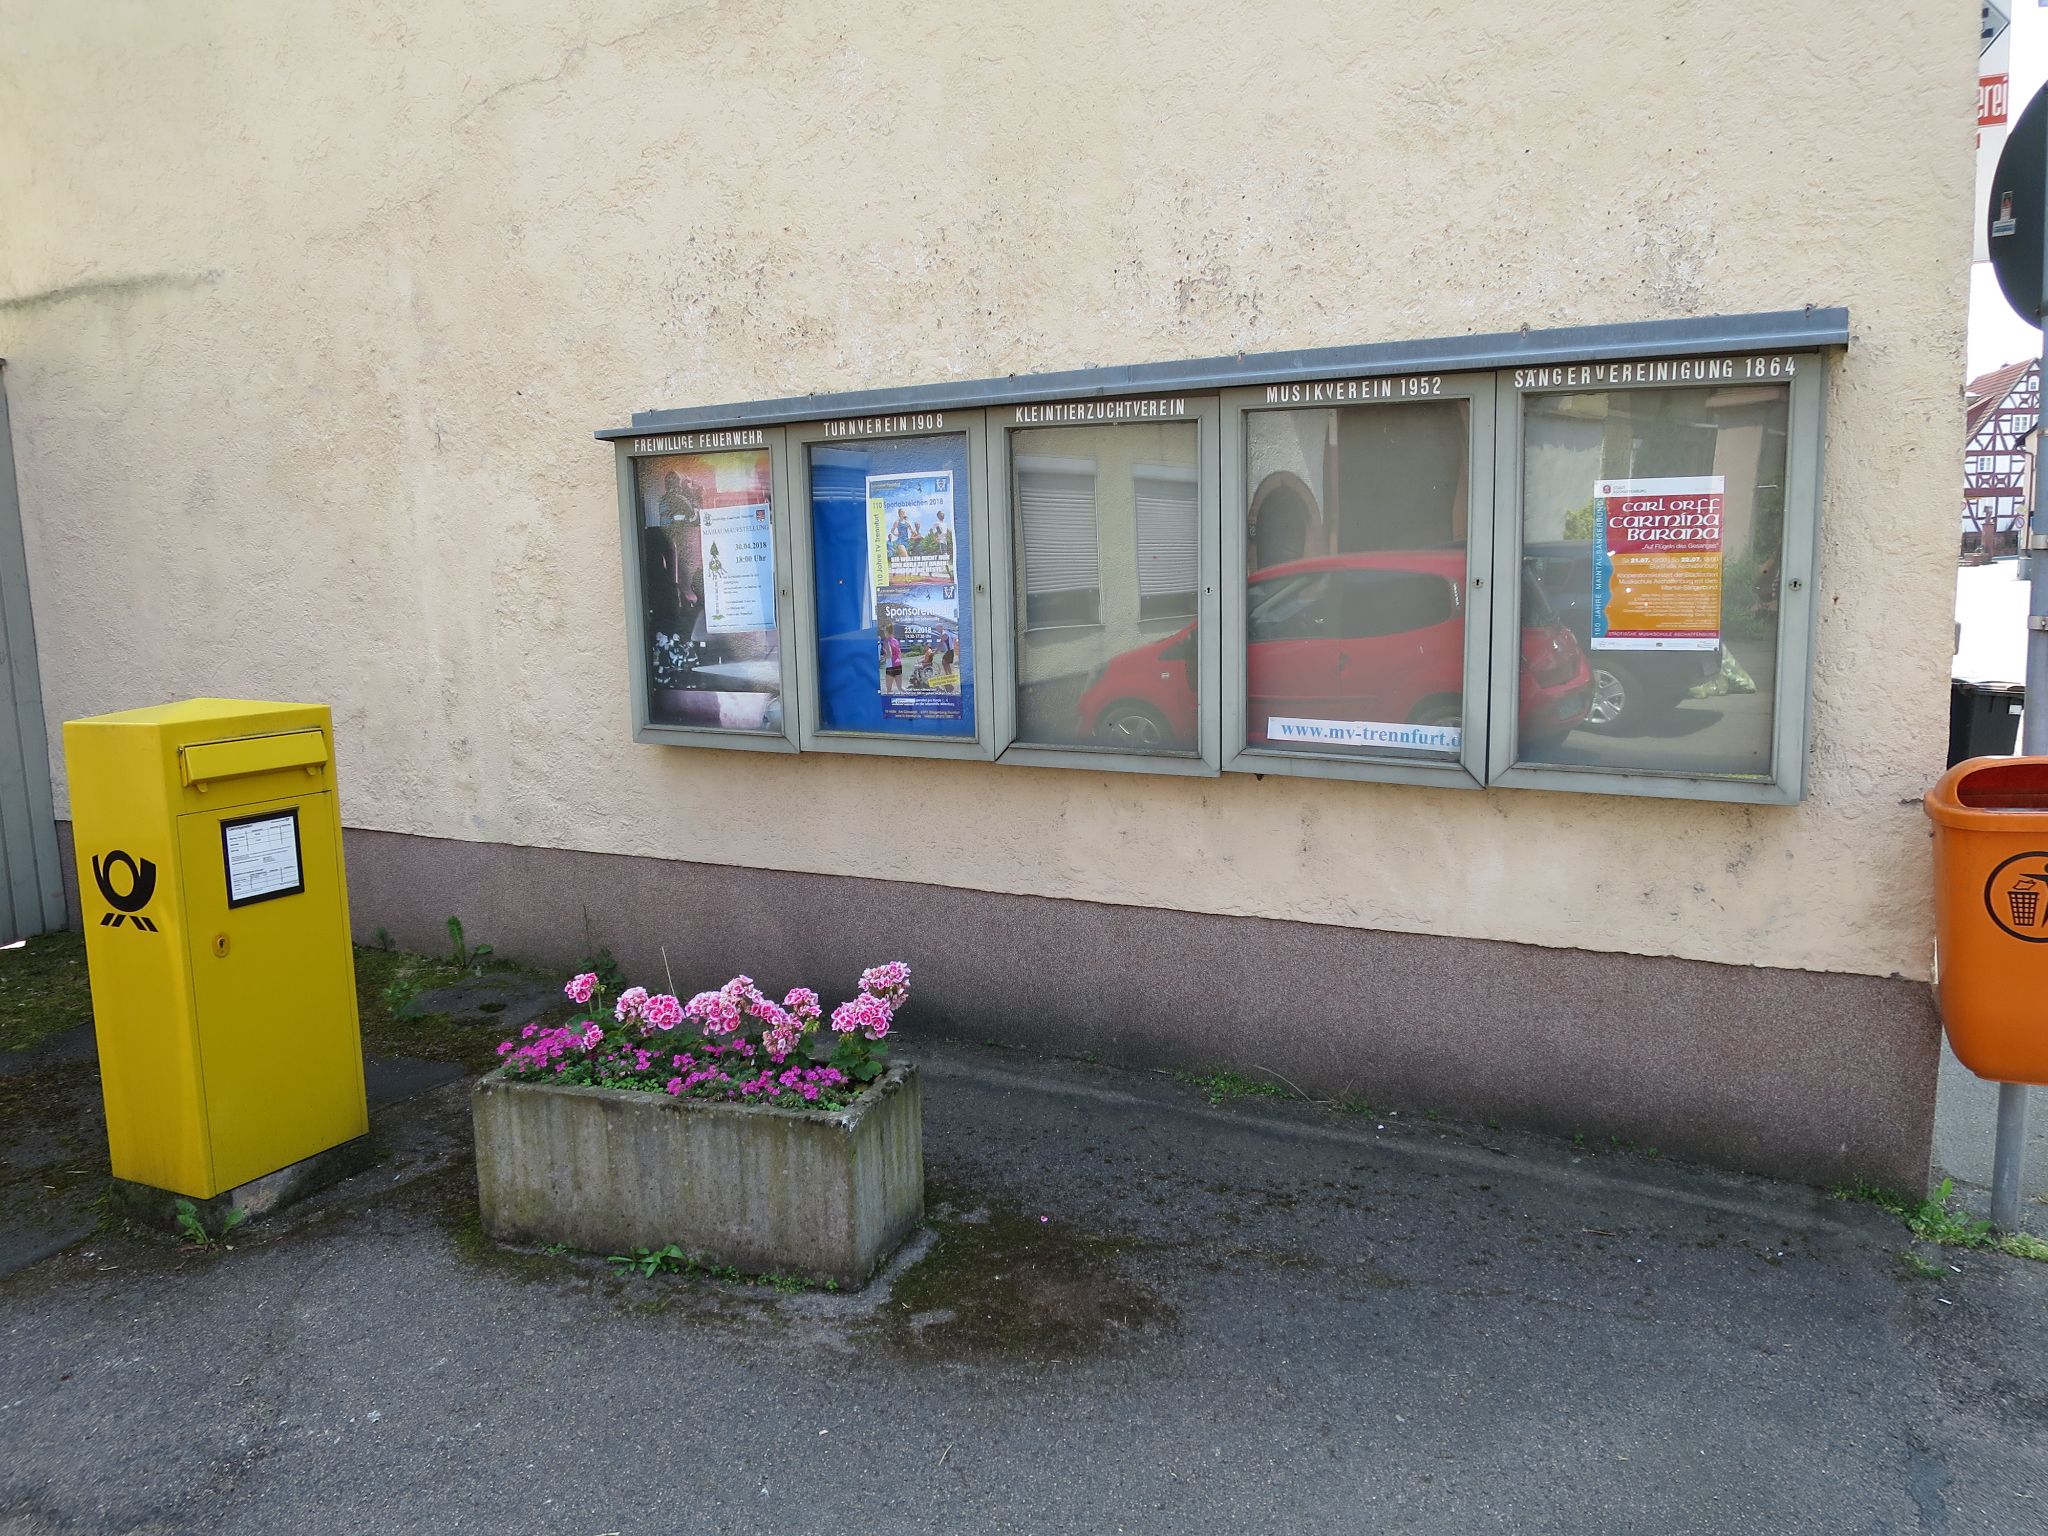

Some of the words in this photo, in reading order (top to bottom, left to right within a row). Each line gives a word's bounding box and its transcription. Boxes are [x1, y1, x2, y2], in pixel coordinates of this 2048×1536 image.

[1515, 358, 1733, 388] SÄNGERVEREINIGUNG
[1745, 356, 1797, 378] 1864
[1266, 379, 1392, 403] MUSIKVEREIN
[1401, 376, 1442, 396] 1952
[1015, 399, 1185, 423] KLEINTIERZUCHTVEREIN
[824, 416, 907, 436] TURNVEREIN
[911, 413, 943, 430] 1908
[634, 435, 694, 453] FREIWILLIGE
[700, 430, 763, 448] FEUERWEHR
[929, 497, 944, 505] 2018
[735, 542, 767, 551] 30.04.2018
[735, 556, 752, 564] 18:00
[754, 554, 767, 562] Uhr
